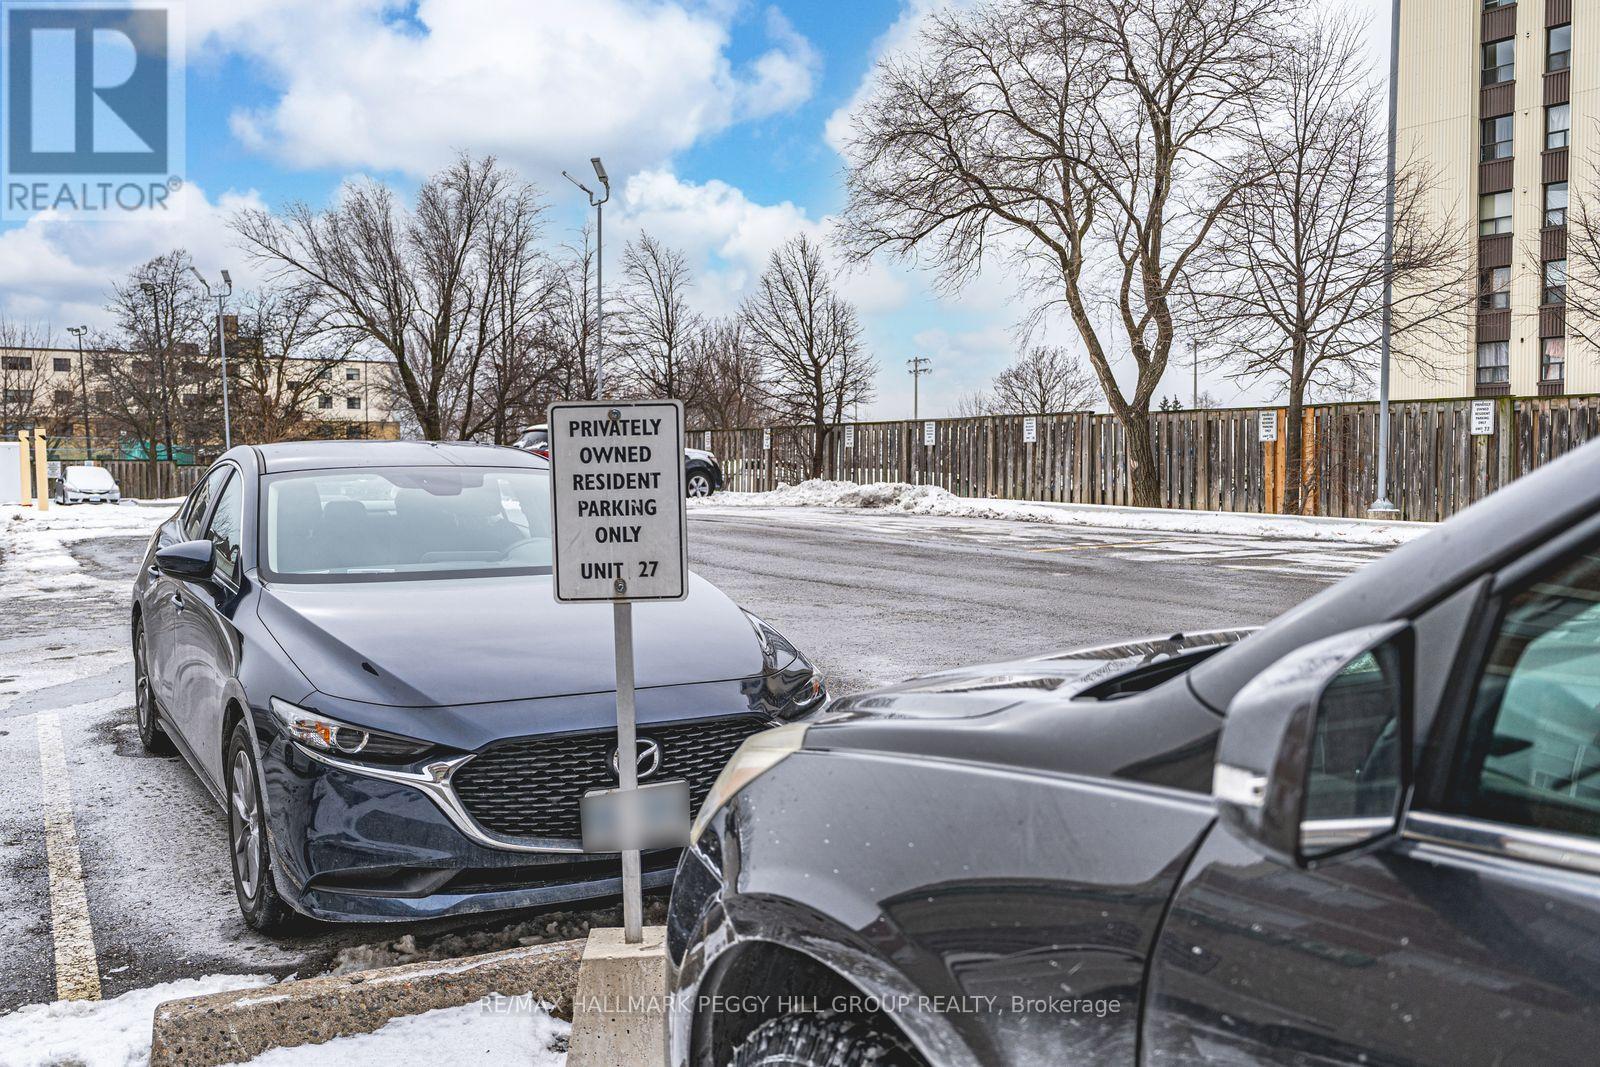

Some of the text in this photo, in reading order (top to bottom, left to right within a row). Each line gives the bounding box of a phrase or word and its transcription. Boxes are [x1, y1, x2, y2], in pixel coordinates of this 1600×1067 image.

[569, 418, 662, 437] PRIVATELY
[579, 446, 652, 464] OWNED
[573, 472, 661, 491] RESIDENT
[578, 499, 657, 517] PARKING
[595, 526, 642, 543] ONLY
[580, 561, 659, 579] UNIT 27
